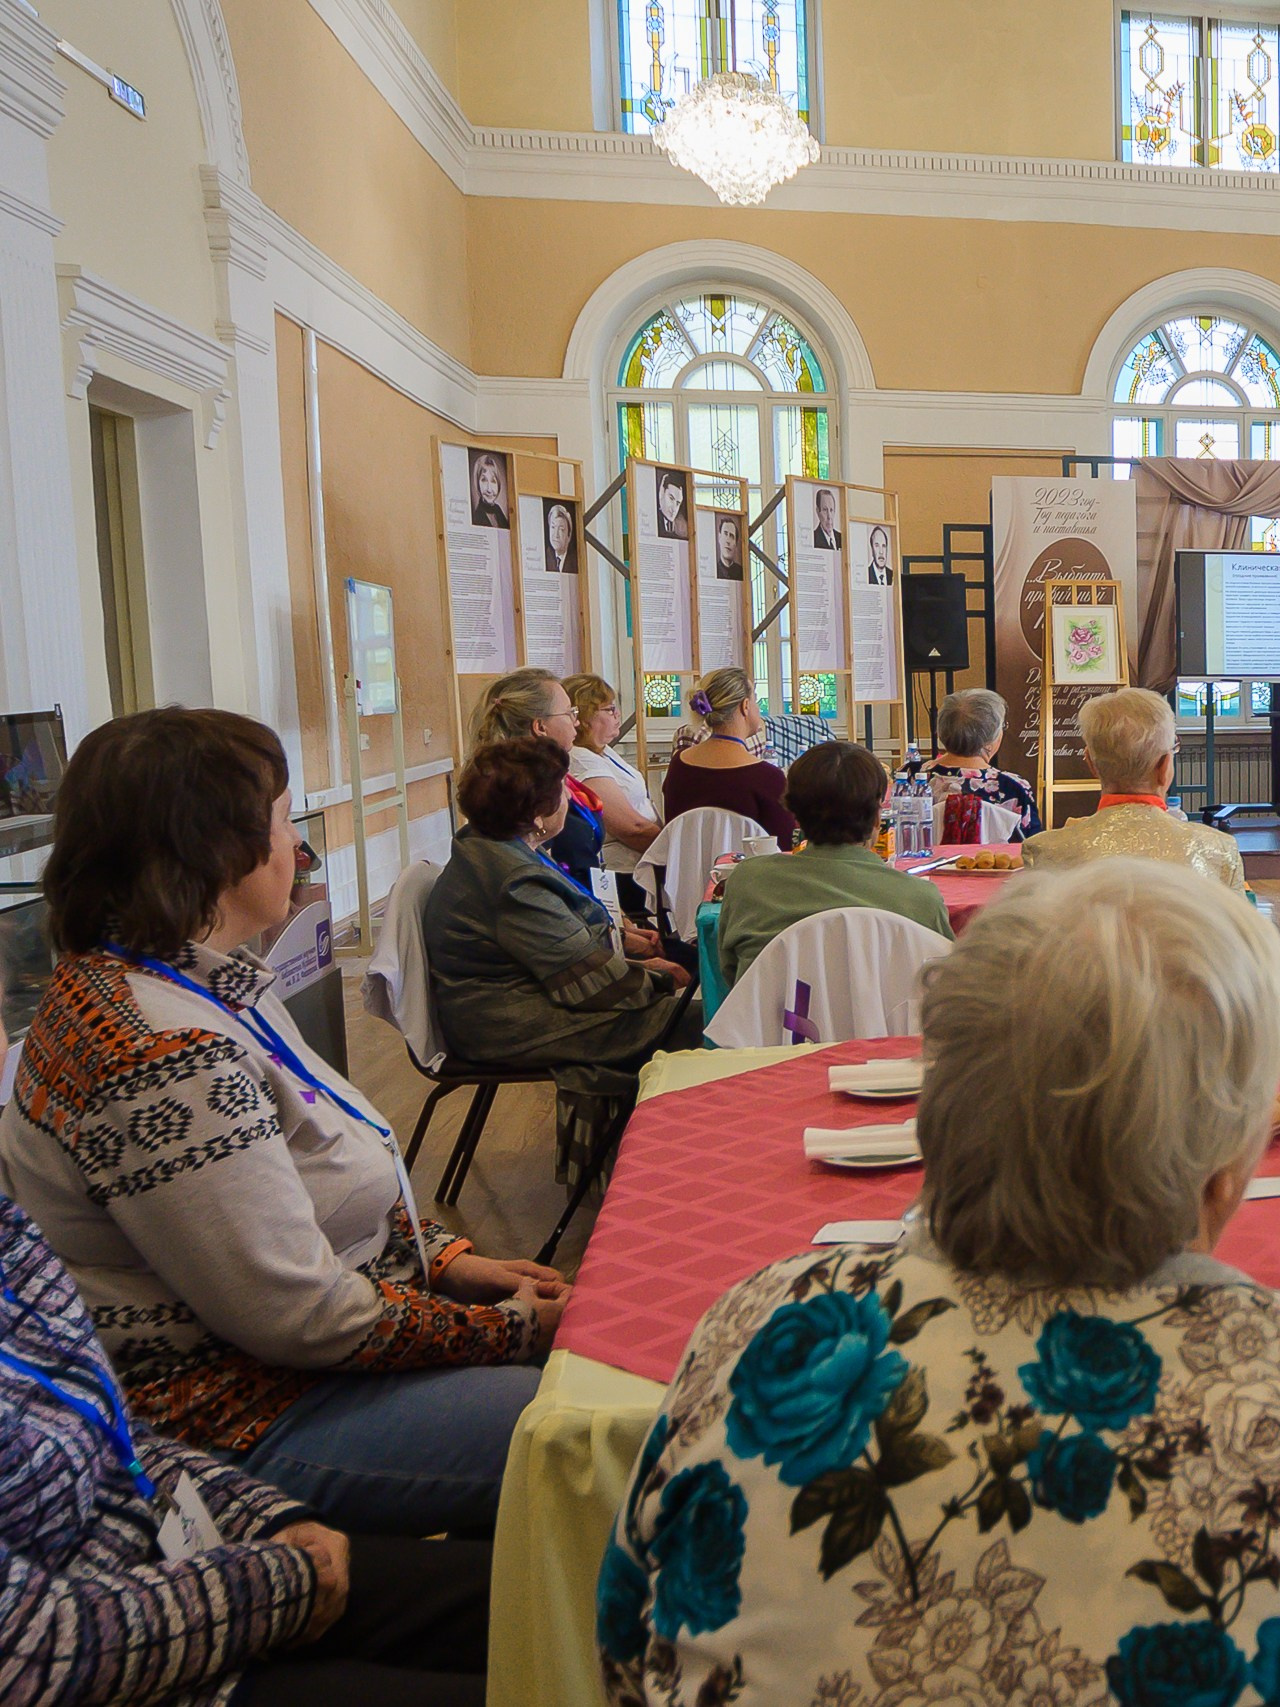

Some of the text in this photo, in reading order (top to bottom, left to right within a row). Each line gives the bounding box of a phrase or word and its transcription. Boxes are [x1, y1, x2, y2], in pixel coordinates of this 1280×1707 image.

[1033, 506, 1097, 525] Год педагога
[1033, 520, 1098, 534] и наставника
